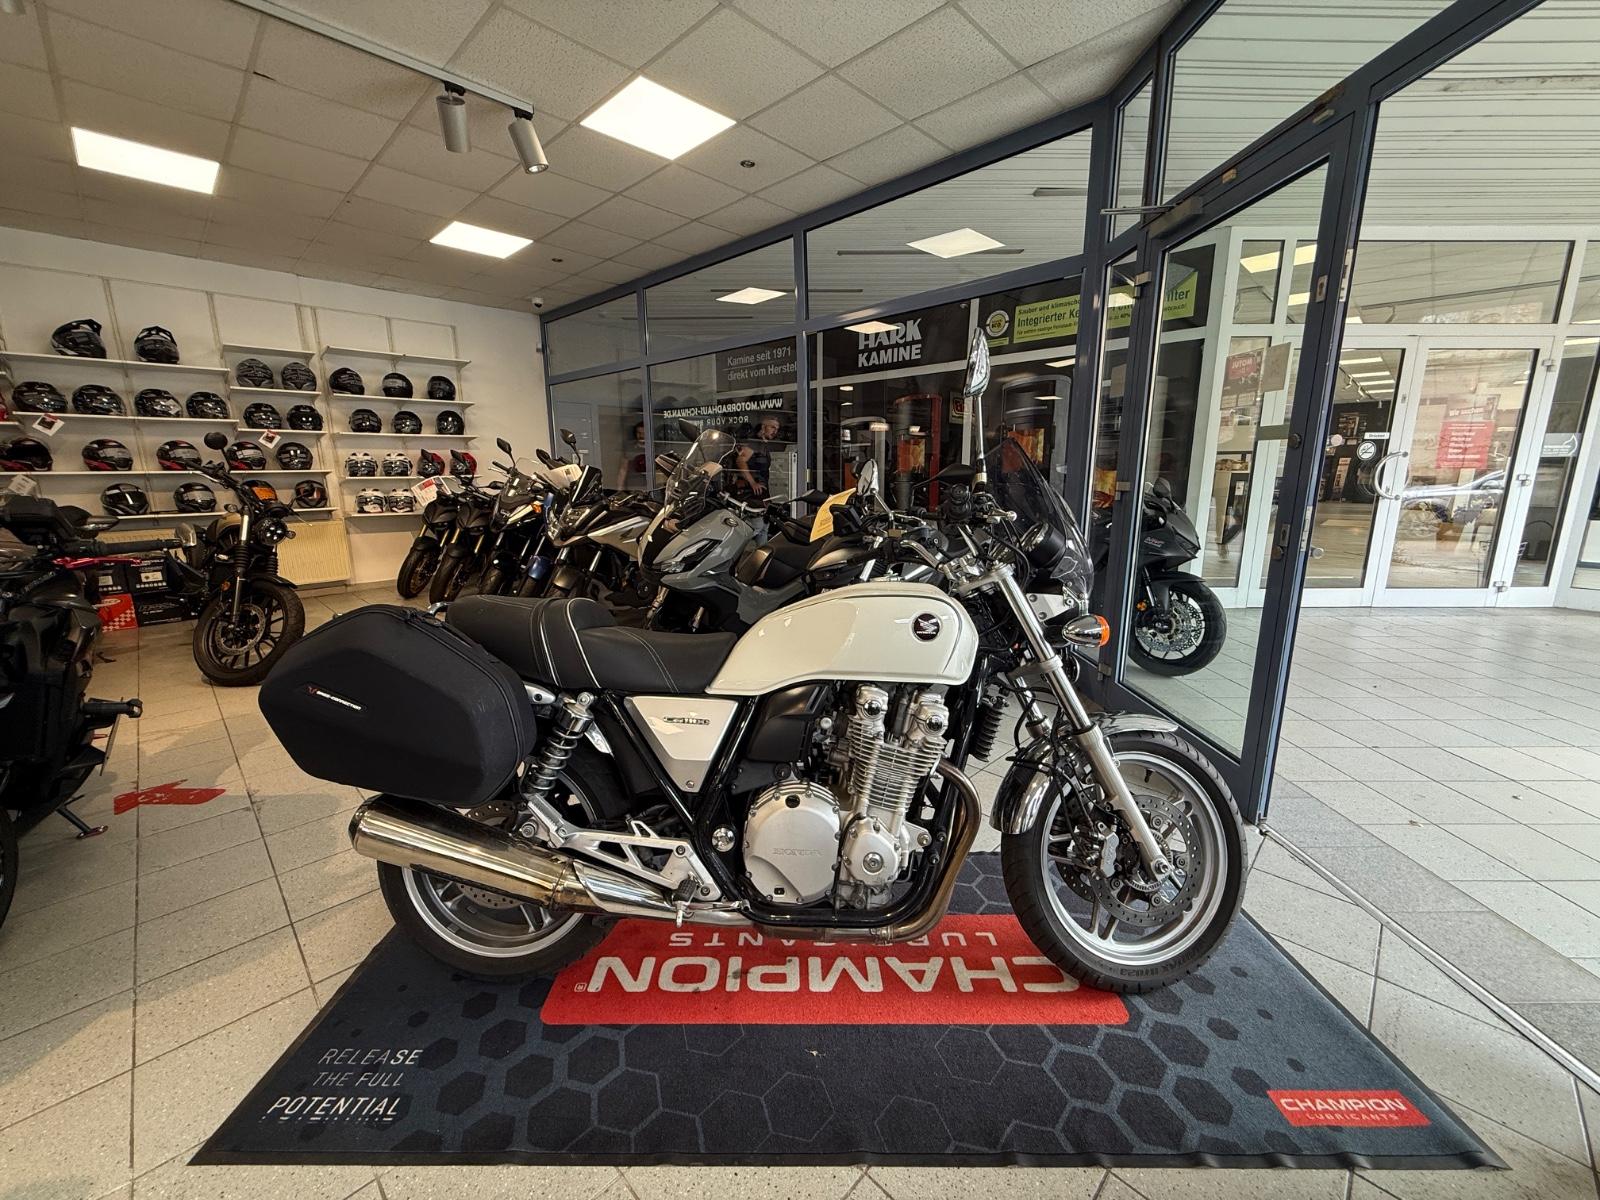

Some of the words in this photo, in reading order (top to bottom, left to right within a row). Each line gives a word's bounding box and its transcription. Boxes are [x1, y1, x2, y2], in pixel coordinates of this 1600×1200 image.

[1018, 312, 1066, 328] Integrierter
[858, 318, 922, 350] HARK
[727, 354, 755, 367] Kamine
[756, 350, 771, 362] seit
[773, 346, 791, 359] 1971
[858, 344, 922, 367] KAMINE
[727, 369, 749, 381] direkt
[750, 367, 766, 378] vom
[586, 956, 1080, 993] CHAMPION
[317, 1048, 424, 1065] RELEASE
[312, 1071, 354, 1087] THE
[355, 1071, 405, 1087] FULL
[266, 1096, 402, 1116] POTENTIAL
[1280, 1098, 1408, 1111] CHAMPION
[1308, 1113, 1400, 1121] LUBRICANTS
